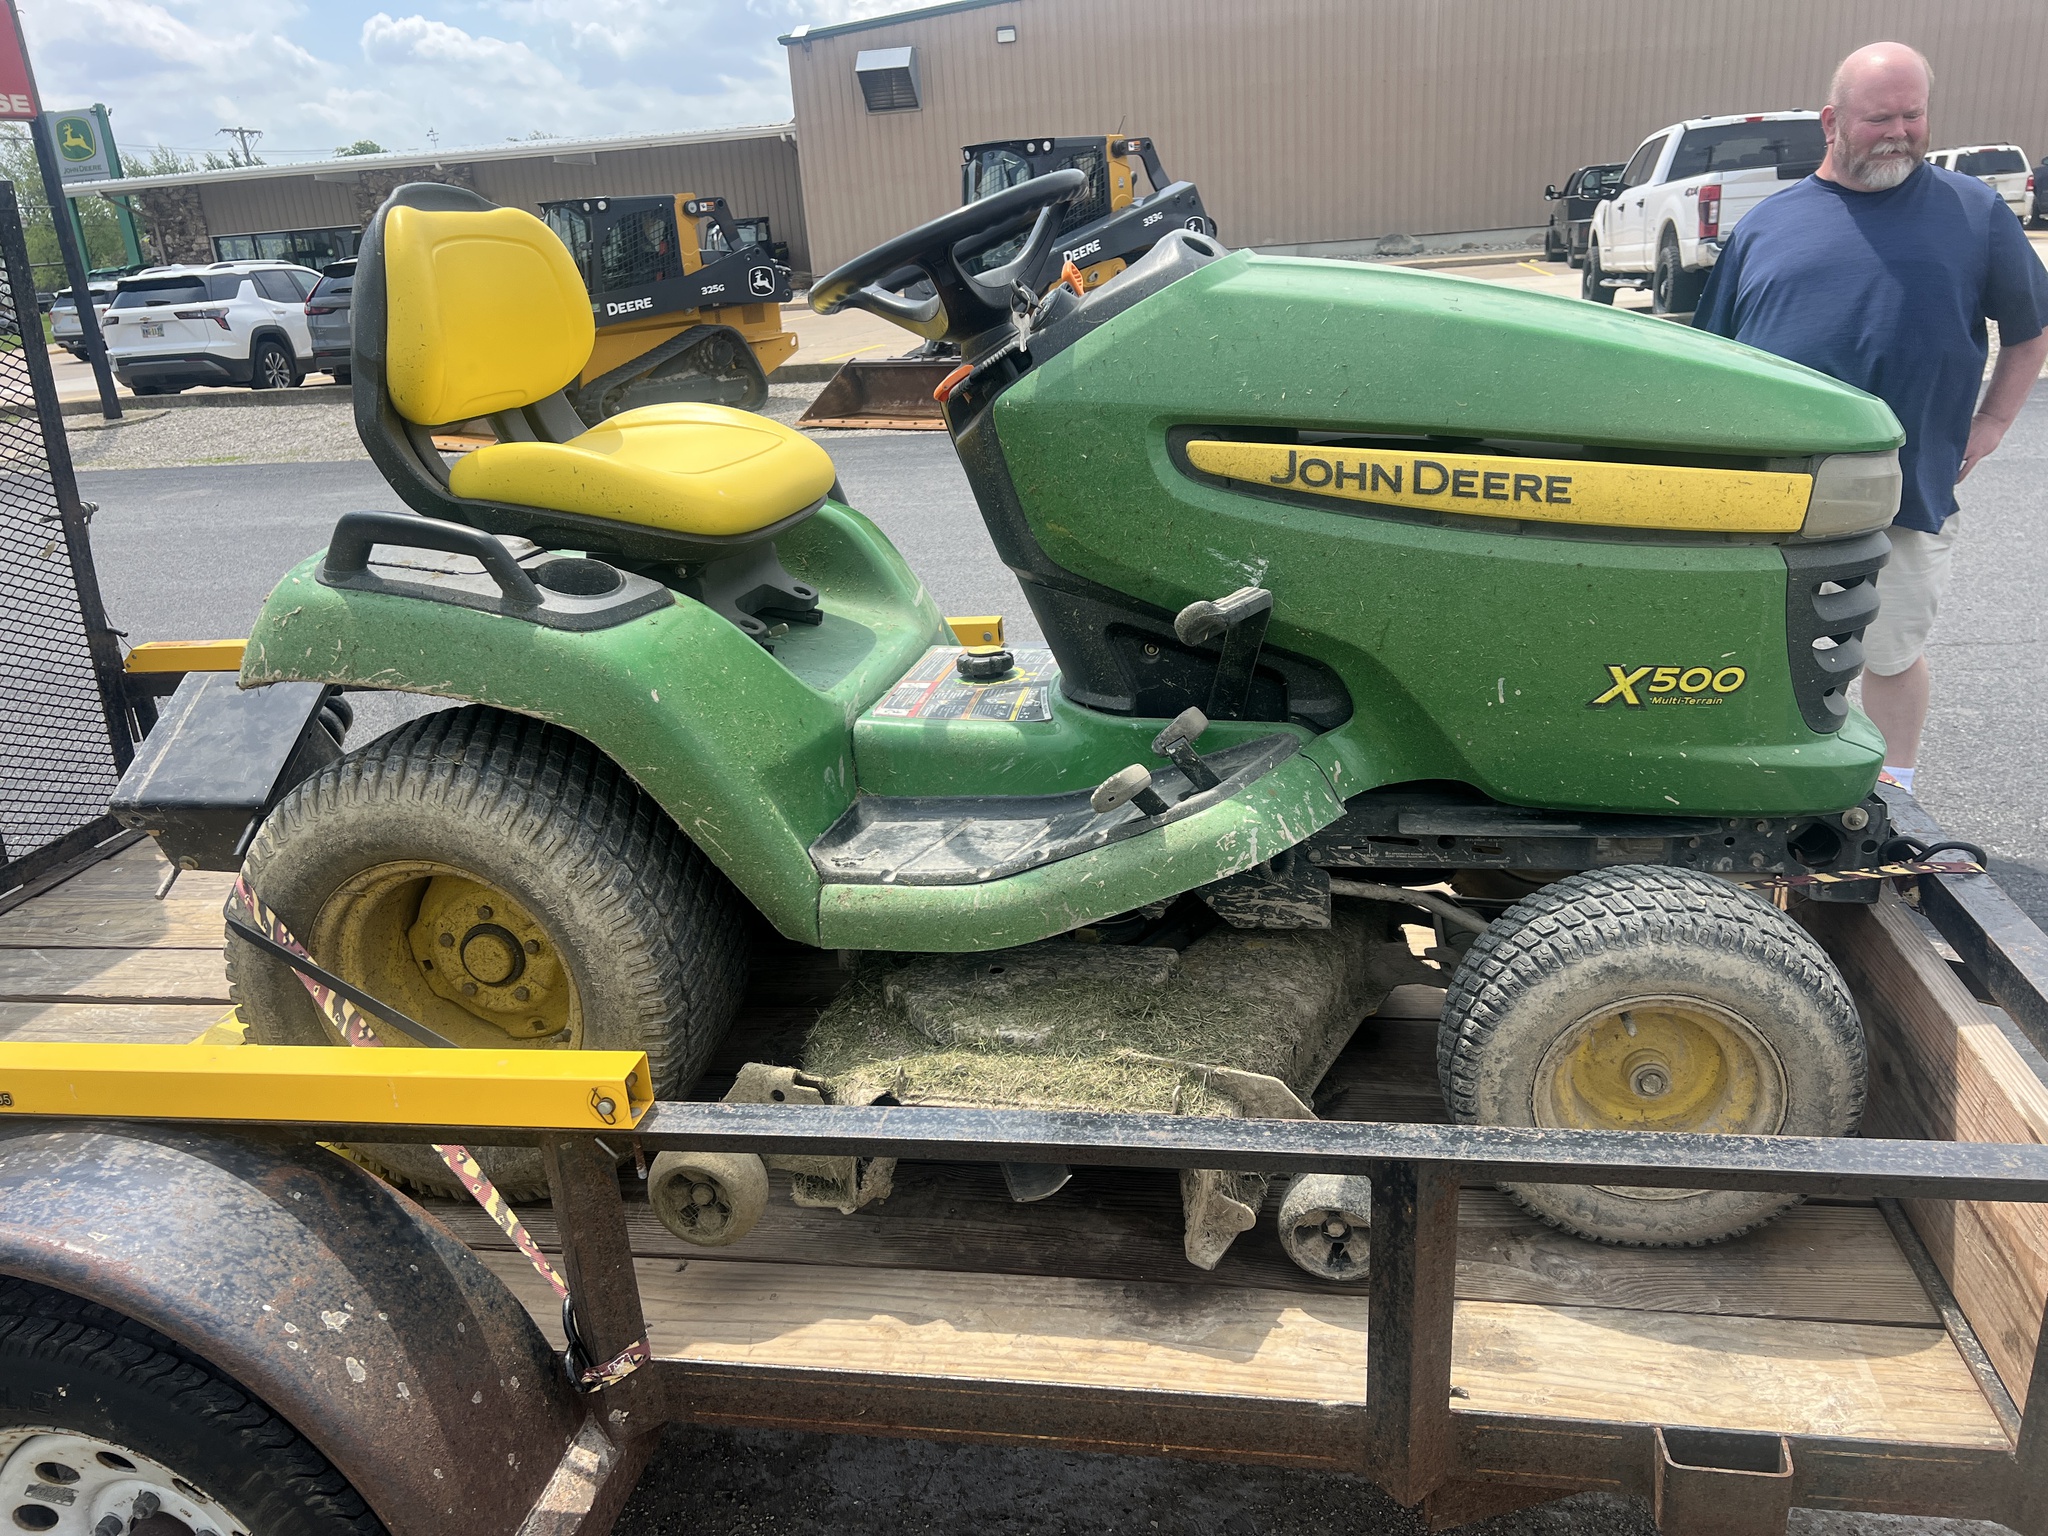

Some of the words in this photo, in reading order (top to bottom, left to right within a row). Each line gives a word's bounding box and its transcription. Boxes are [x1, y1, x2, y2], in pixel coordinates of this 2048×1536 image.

[79, 164, 102, 172] DEERE
[1142, 212, 1163, 227] 333G
[1063, 239, 1101, 262] DEERE
[700, 284, 725, 295] 325G
[606, 297, 654, 316] DEERE
[1270, 450, 1402, 493] JOHN
[1413, 459, 1573, 504] DEERE
[1589, 665, 1747, 706] X500
[1651, 696, 1723, 706] Multi-Terrain
